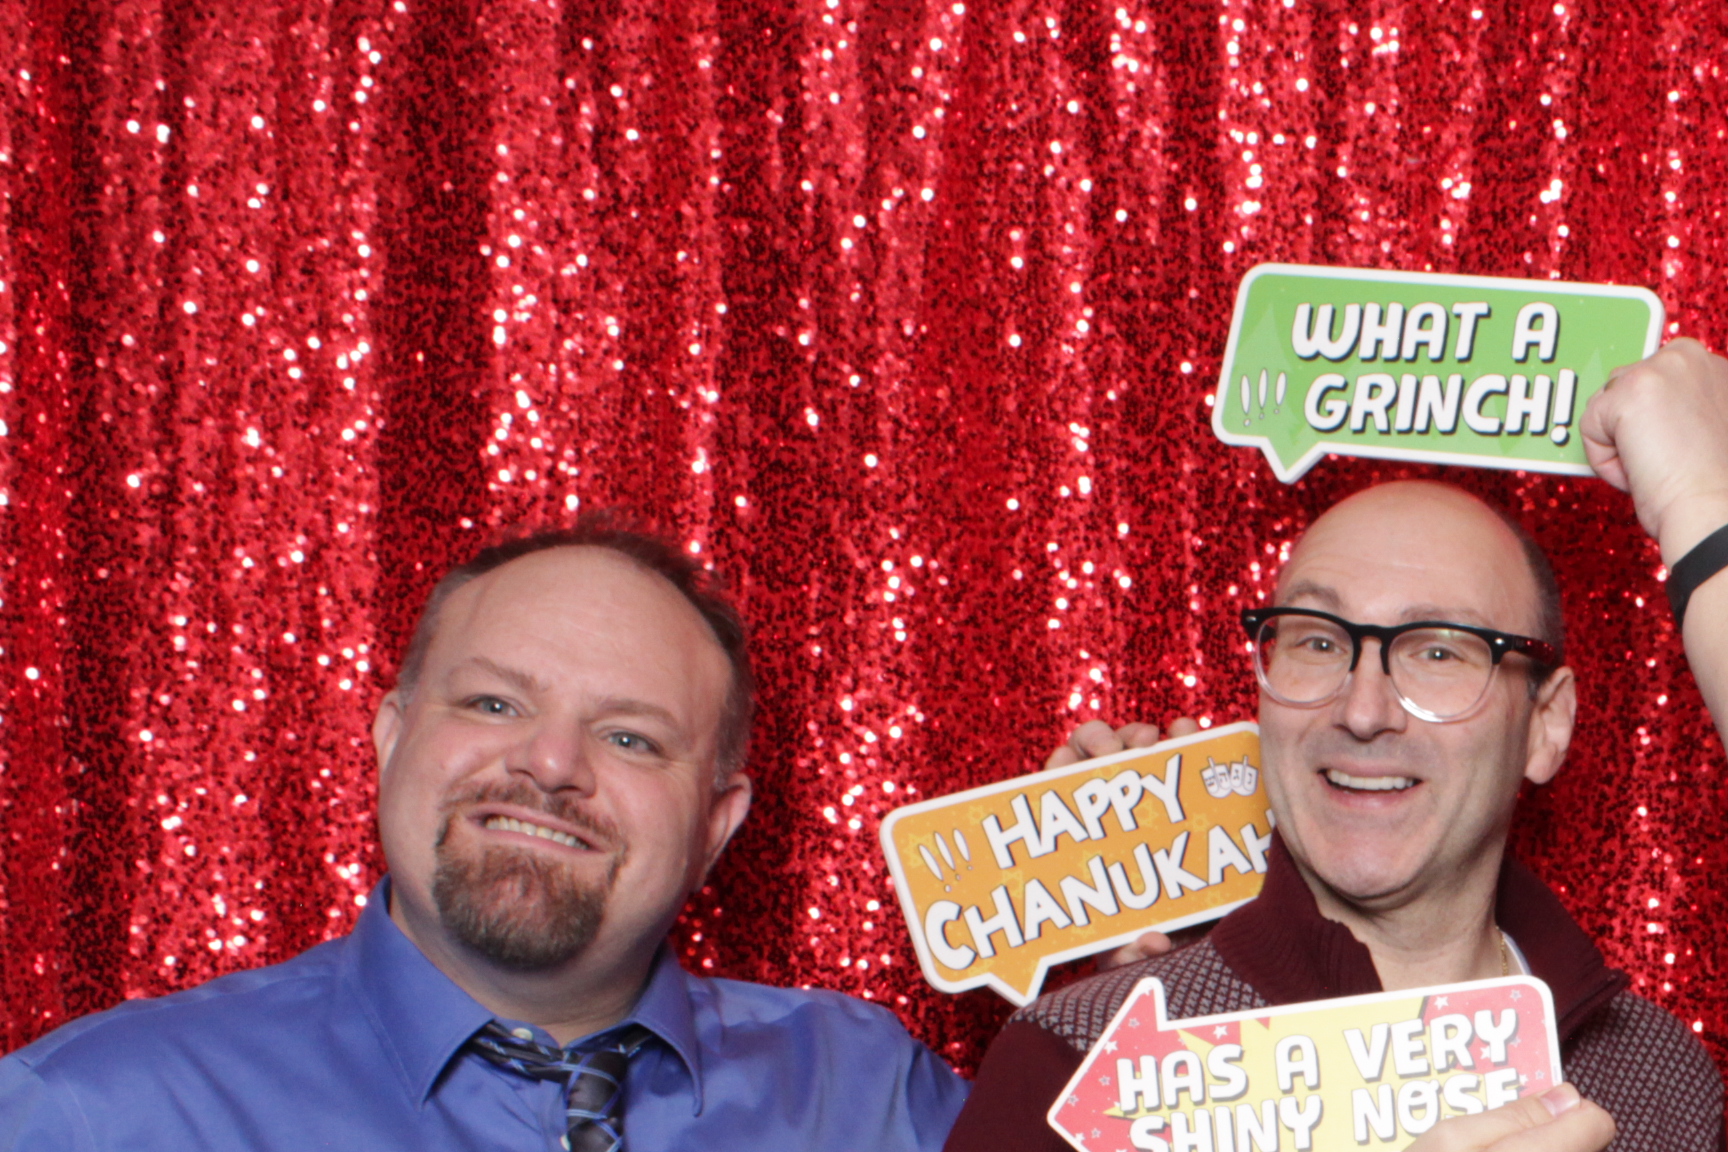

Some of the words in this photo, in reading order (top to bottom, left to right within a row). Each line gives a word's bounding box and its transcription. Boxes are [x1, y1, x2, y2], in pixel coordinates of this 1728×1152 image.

[1291, 302, 1490, 362] WHAT
[1512, 302, 1560, 362] A
[1304, 369, 1577, 446] GRINCH!
[981, 753, 1186, 870] HAPPY
[1116, 1043, 1250, 1114] HAS
[1275, 1034, 1321, 1094] A
[1343, 1007, 1521, 1082] VERY
[1351, 1067, 1521, 1146] NOSE
